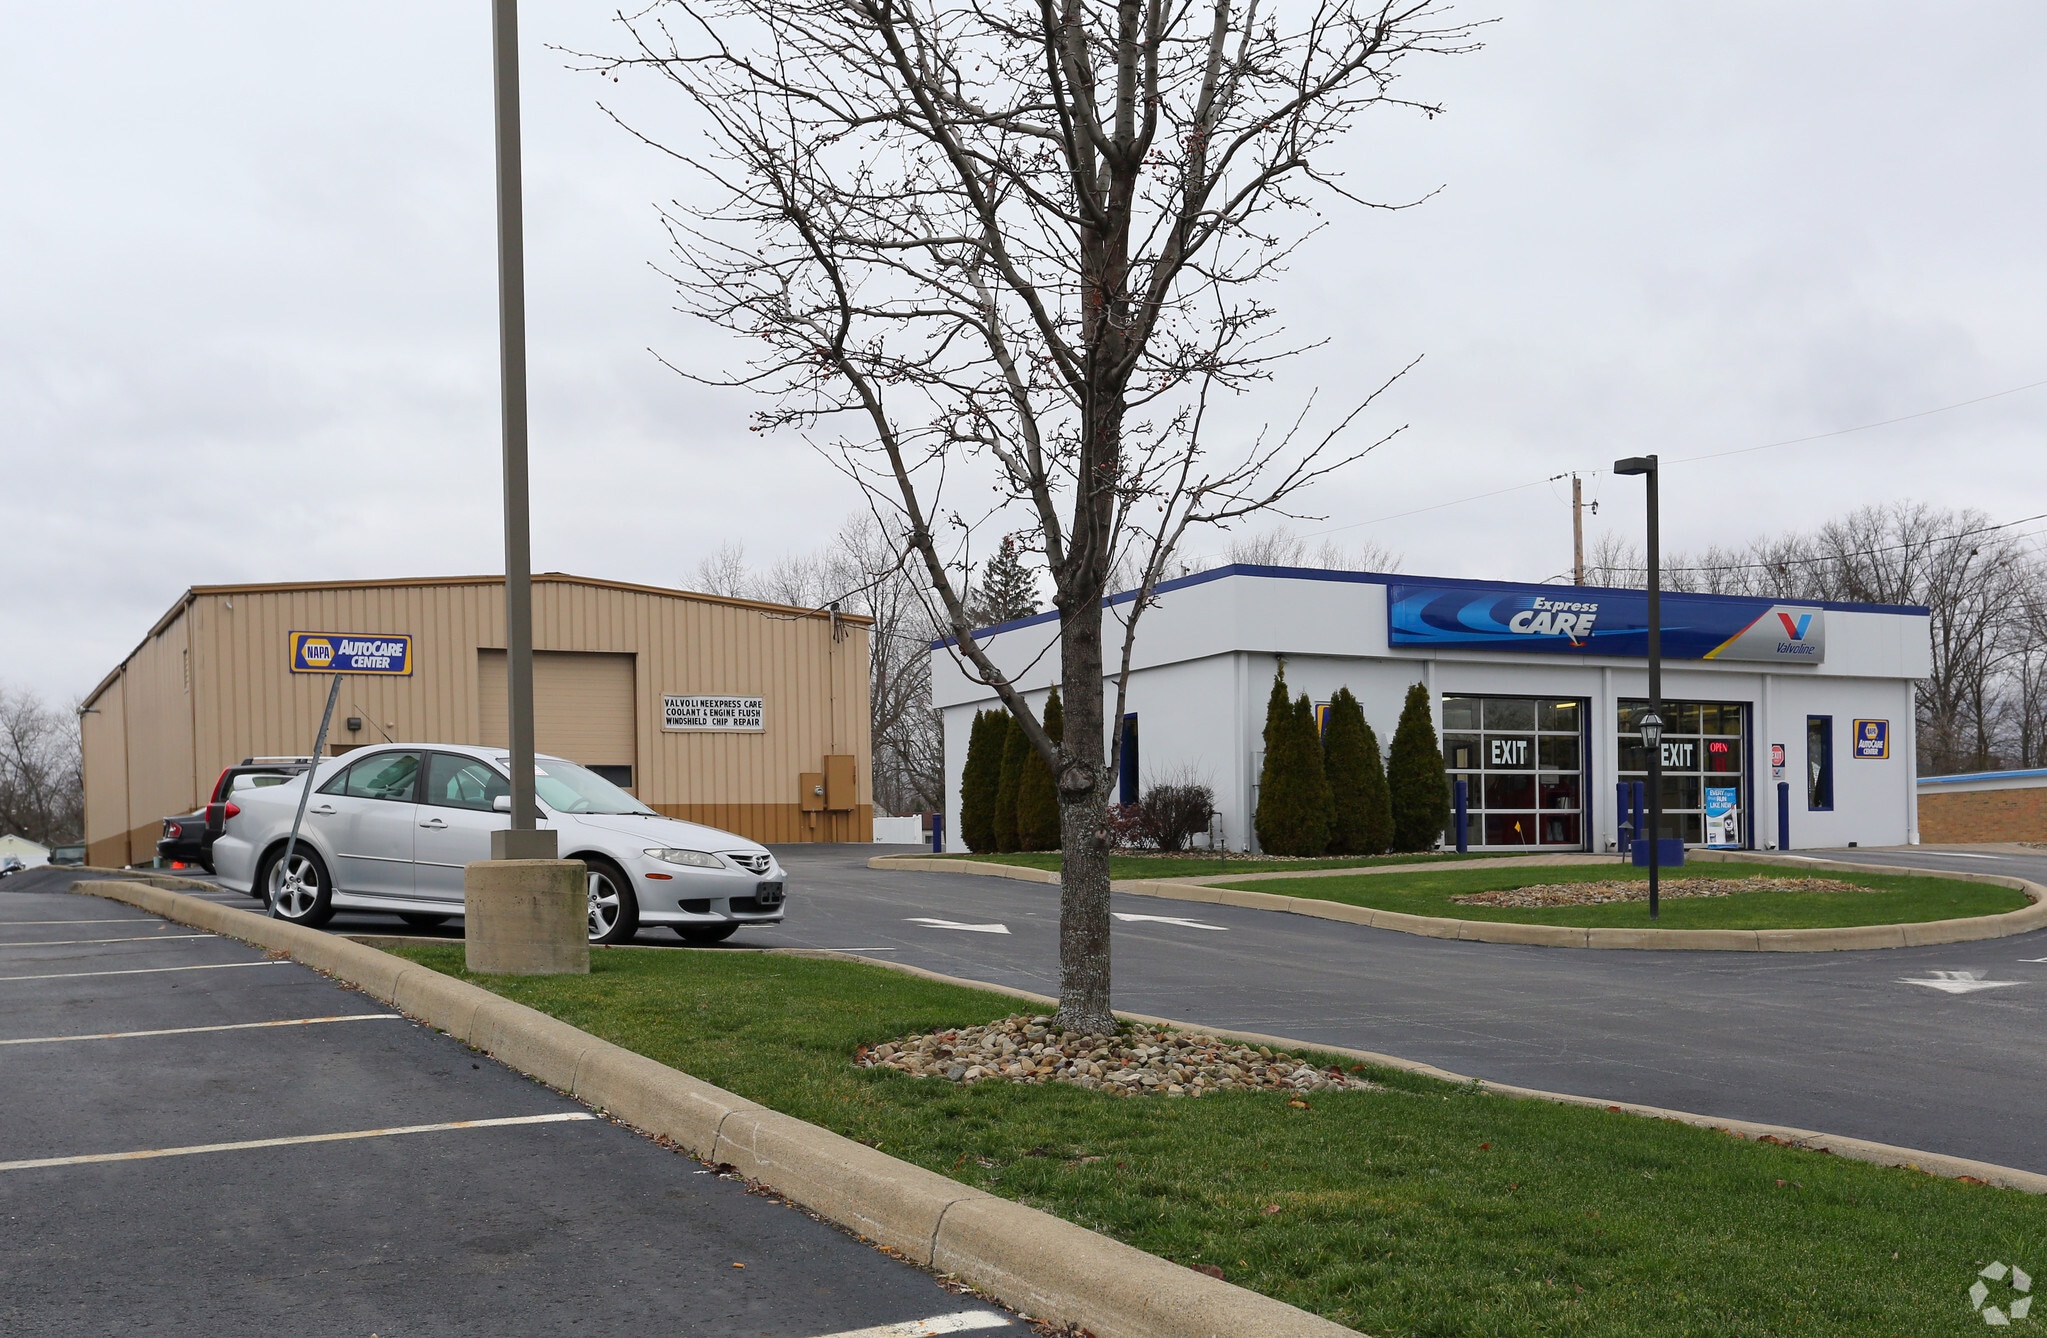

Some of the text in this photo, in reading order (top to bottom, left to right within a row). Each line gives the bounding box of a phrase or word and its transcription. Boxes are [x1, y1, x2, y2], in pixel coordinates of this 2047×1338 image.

[1533, 597, 1598, 612] Express
[1509, 610, 1596, 645] CARE
[307, 646, 330, 659] NAPA
[1776, 643, 1815, 654] Valvoline
[351, 656, 390, 668] CENTER
[666, 708, 700, 716] COOLANT
[710, 709, 735, 717] ENGINE
[739, 709, 761, 717] FLUSH
[666, 717, 760, 726] WINDSHIELD CHIP REPAIR
[1492, 740, 1527, 764] EXIT
[1709, 742, 1728, 752] OPEN
[1661, 743, 1693, 766] EXIT
